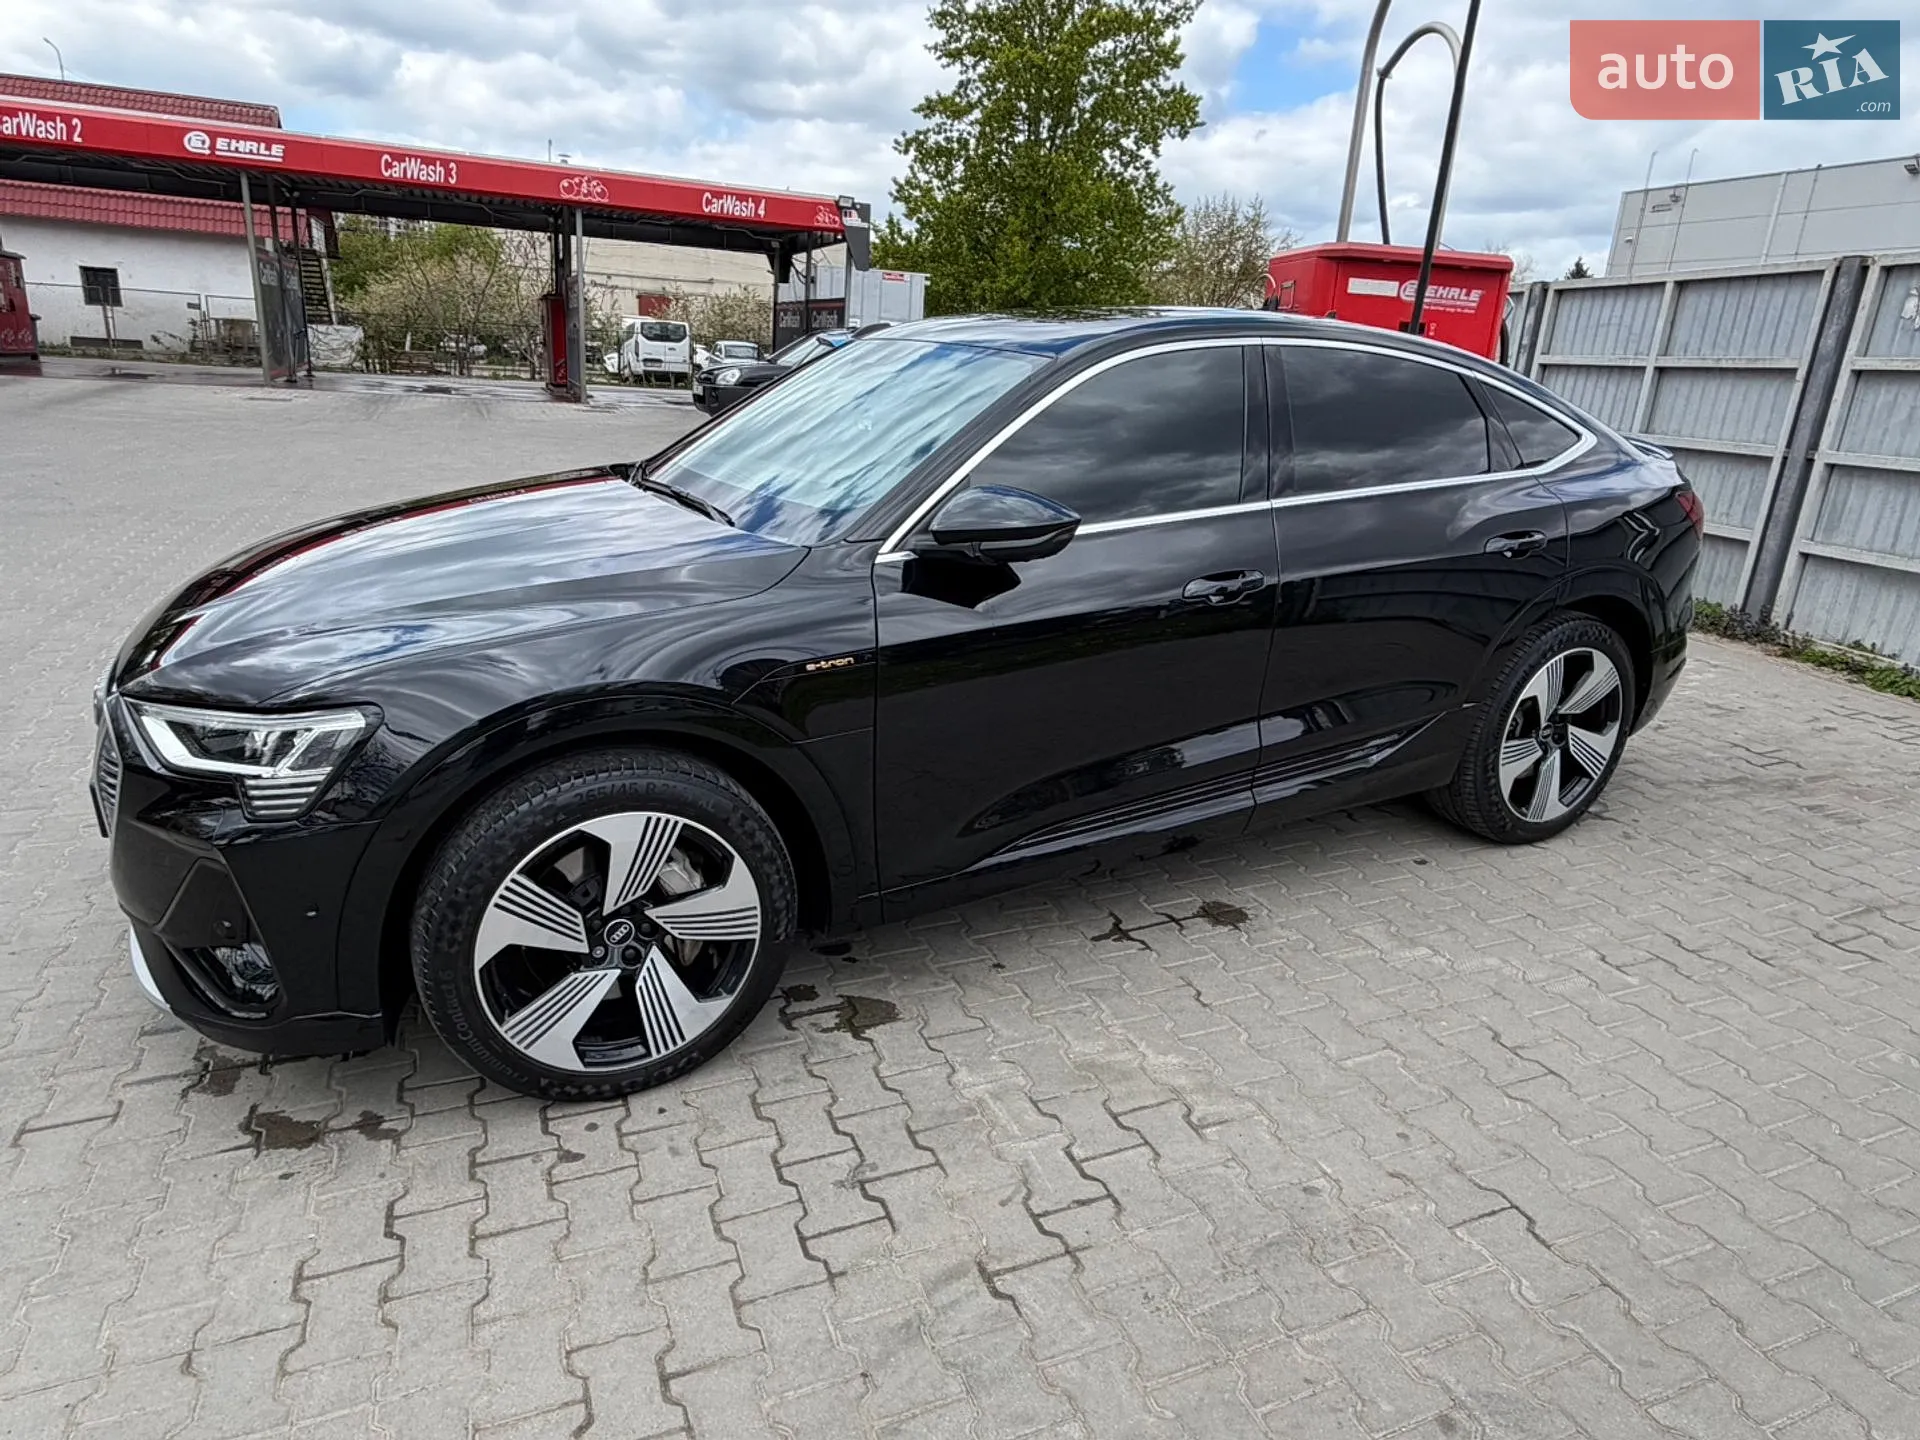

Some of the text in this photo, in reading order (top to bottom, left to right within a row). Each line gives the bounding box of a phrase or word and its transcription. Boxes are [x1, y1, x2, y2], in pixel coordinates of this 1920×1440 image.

[0, 110, 83, 143] arWash 2
[216, 137, 285, 157] EHRLE
[381, 154, 457, 184] CarWash 3
[702, 192, 766, 219] CarWash 4
[1424, 284, 1482, 301] EHRLE
[805, 657, 855, 671] e-tron
